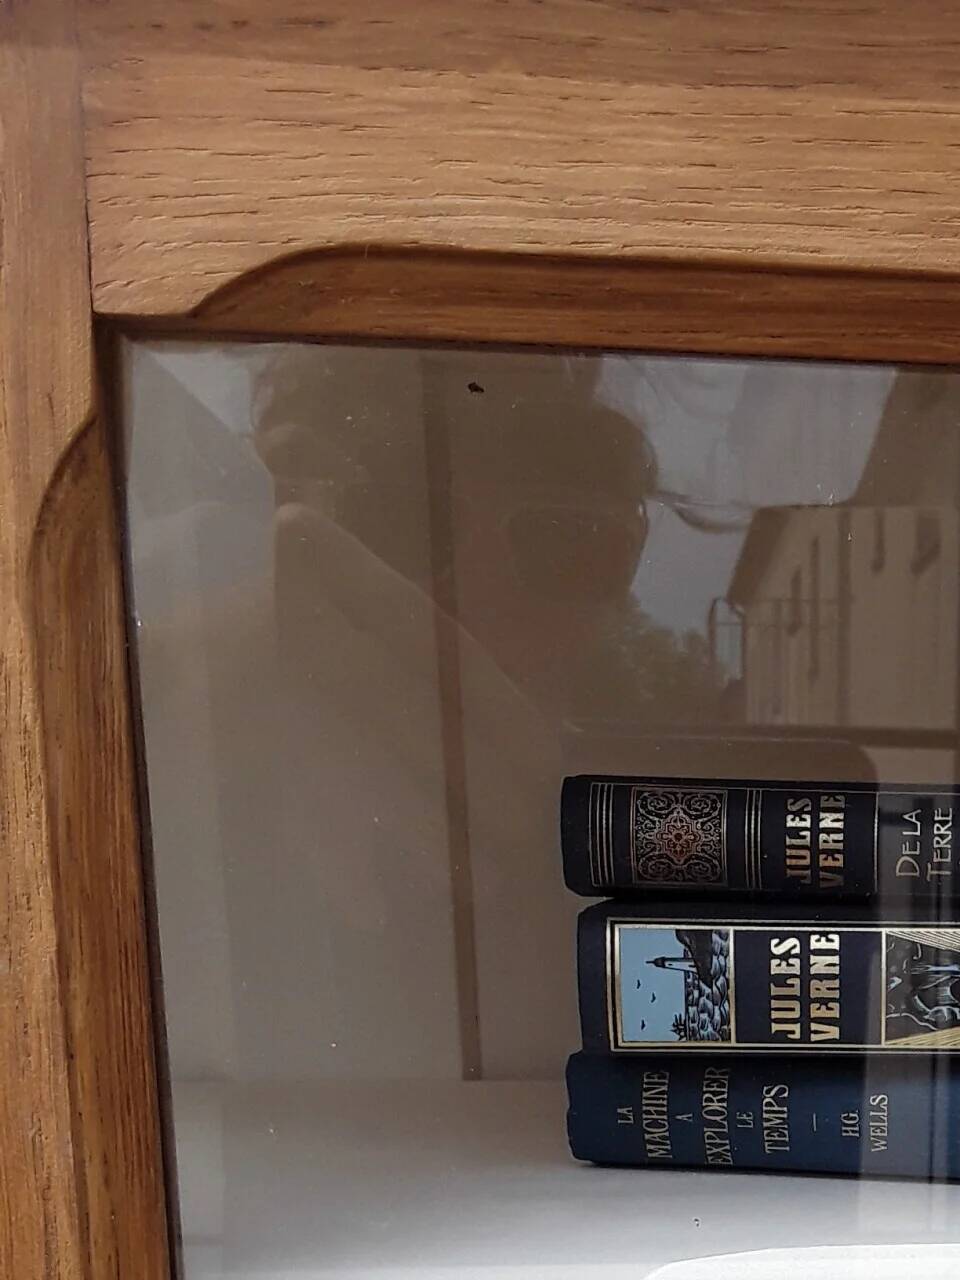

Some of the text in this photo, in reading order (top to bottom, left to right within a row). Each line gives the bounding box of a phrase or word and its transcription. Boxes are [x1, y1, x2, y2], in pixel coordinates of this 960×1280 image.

[785, 797, 812, 884] JULES
[819, 794, 846, 889] VERNE
[896, 809, 922, 877] DE LA
[926, 807, 953, 881] TERRE
[770, 937, 801, 1040] JULES
[810, 933, 840, 1042] VERNE
[617, 1106, 634, 1124] LA
[642, 1071, 673, 1159] MACHINE
[703, 1066, 733, 1166] EXPLORER
[736, 1111, 753, 1129] LE
[763, 1084, 790, 1154] TEMPS
[870, 1094, 889, 1152] WELLS
